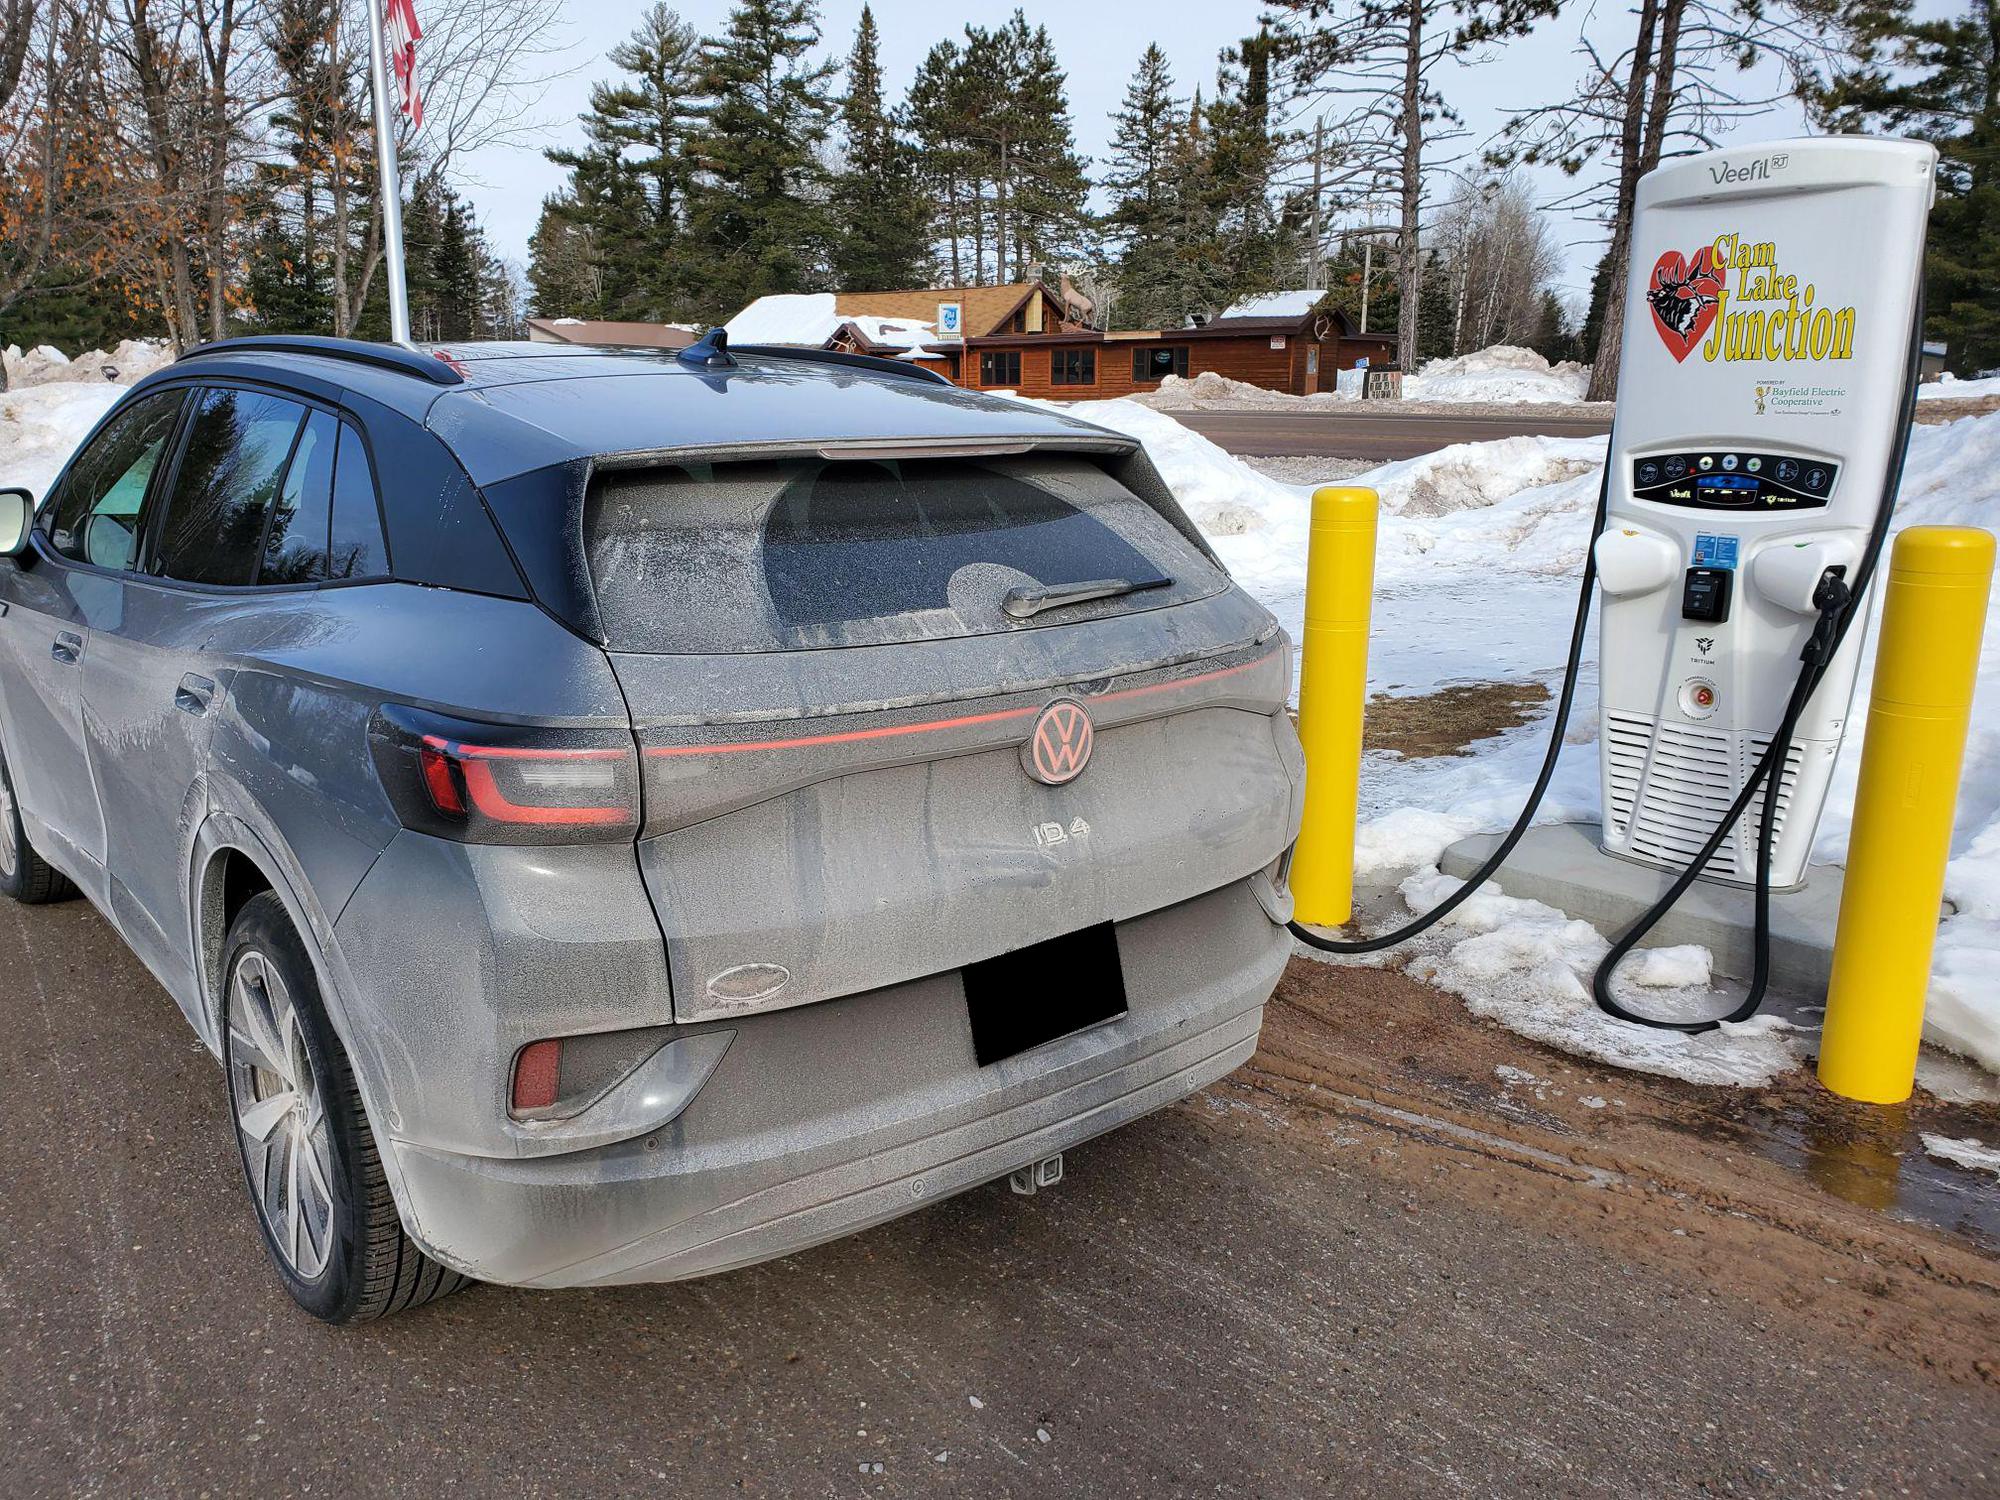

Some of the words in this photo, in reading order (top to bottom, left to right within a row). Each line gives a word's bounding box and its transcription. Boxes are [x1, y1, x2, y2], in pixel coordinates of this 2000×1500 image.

[1709, 158, 1770, 184] Veefil
[1711, 232, 1776, 270] Clam
[1737, 264, 1799, 302] Lake
[1703, 283, 1856, 362] Junction
[1771, 397, 1824, 408] Cooperative
[1772, 387, 1809, 398] Bayfield
[1811, 387, 1847, 397] Electric
